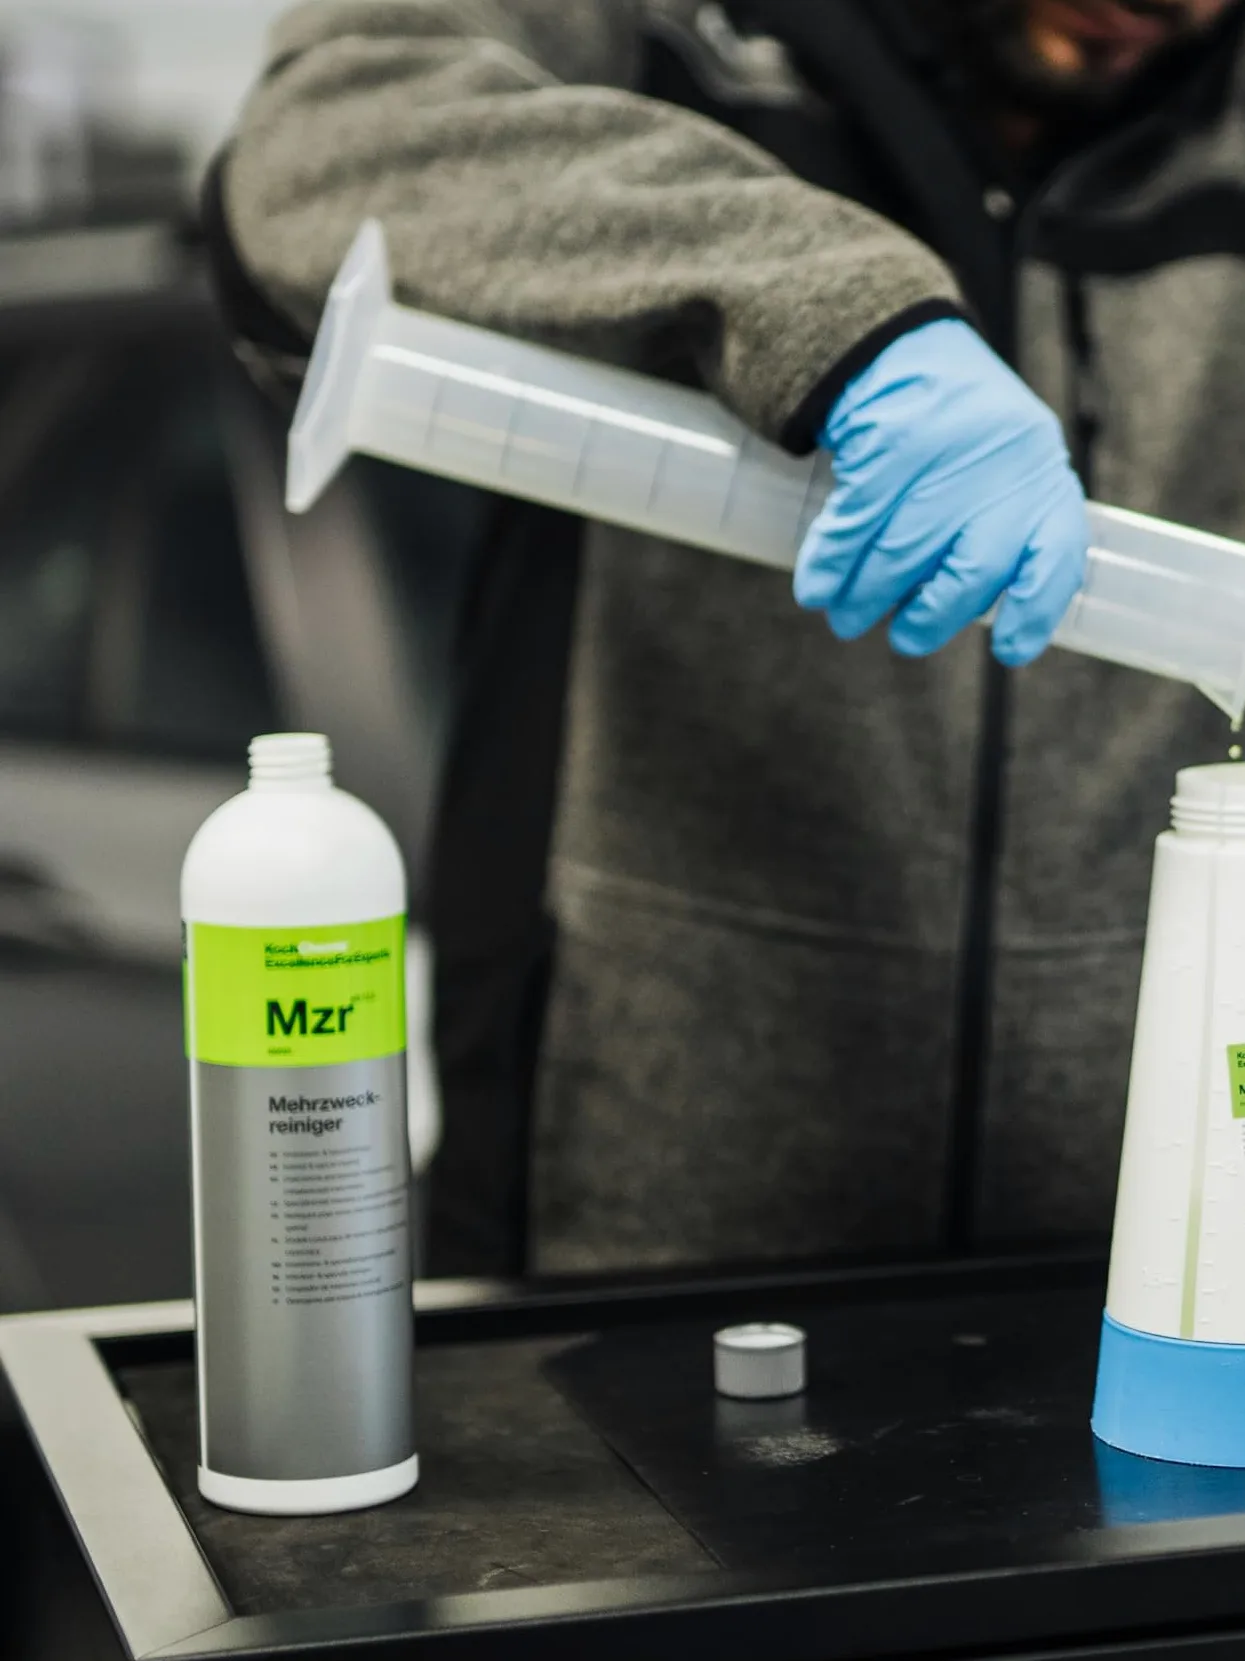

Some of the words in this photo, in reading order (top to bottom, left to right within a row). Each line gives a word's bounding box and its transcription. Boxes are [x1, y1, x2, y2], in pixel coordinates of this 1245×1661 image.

[266, 998, 355, 1036] Mzr
[268, 1090, 380, 1114] Mehrzweck-
[269, 1117, 343, 1136] reiniger
